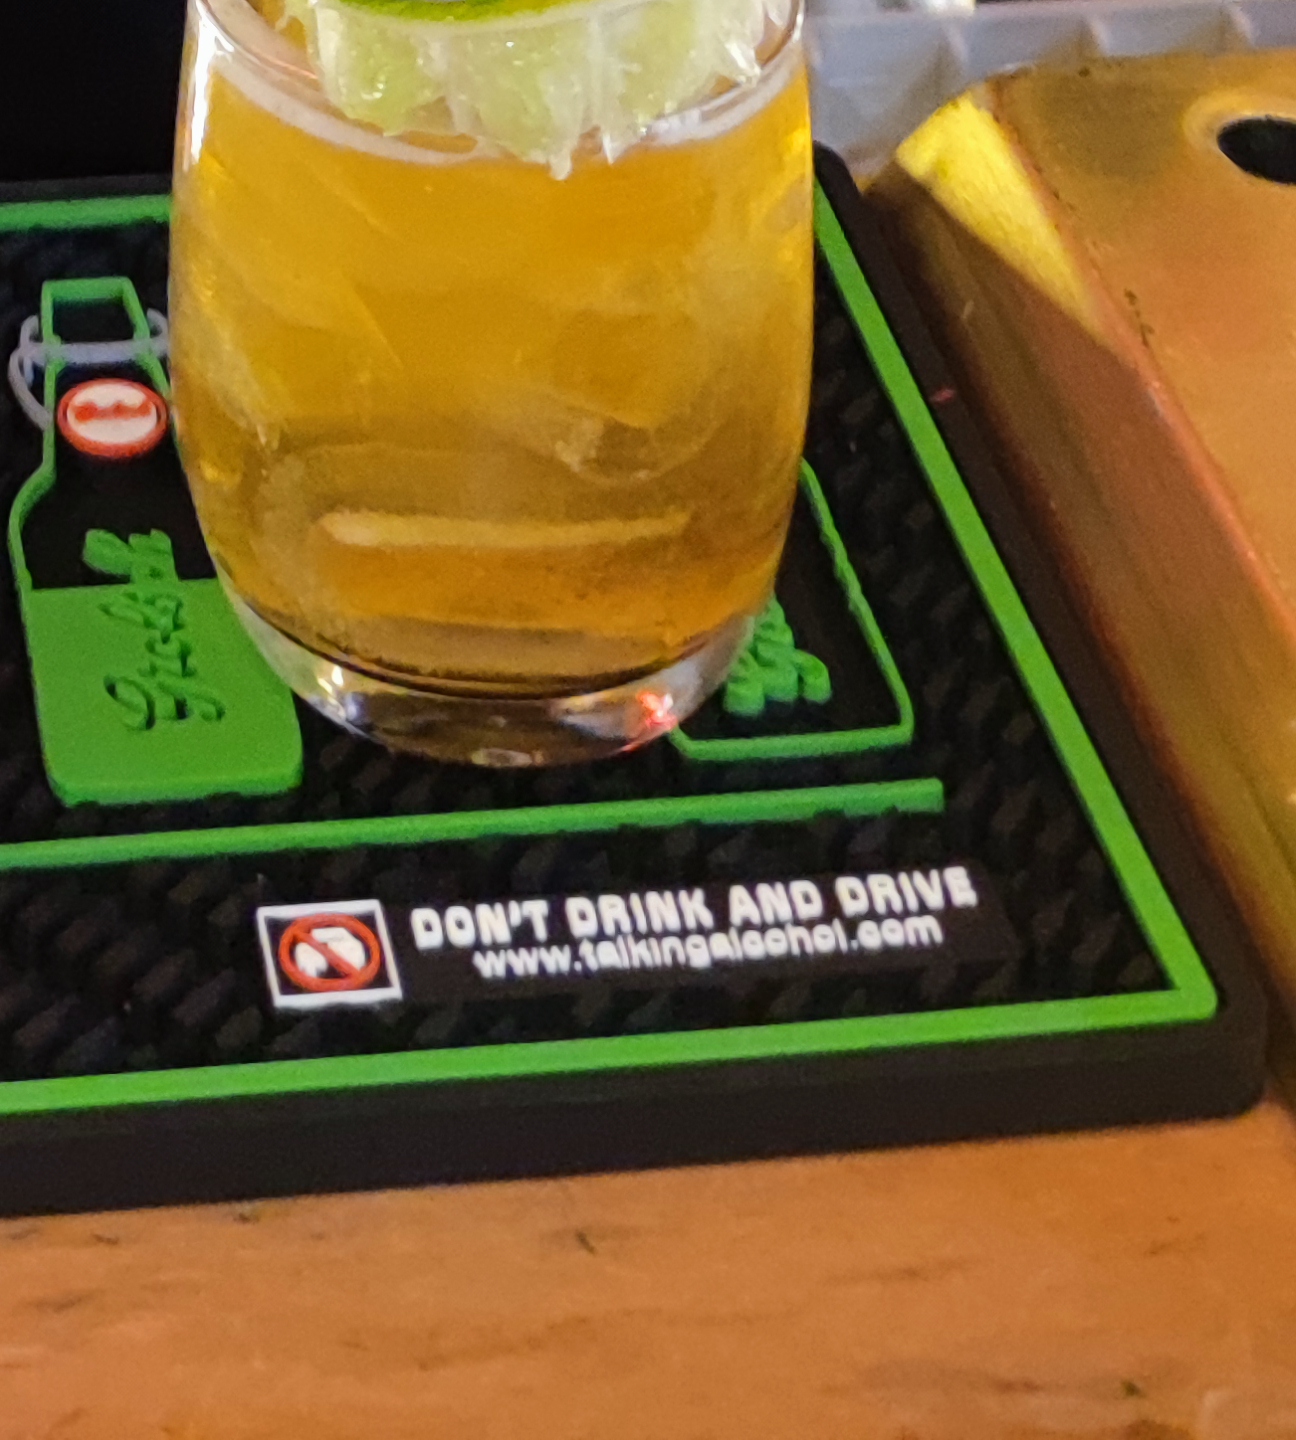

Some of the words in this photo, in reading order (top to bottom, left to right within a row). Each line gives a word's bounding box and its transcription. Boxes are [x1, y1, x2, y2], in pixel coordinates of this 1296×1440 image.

[411, 899, 551, 951] DON'T
[565, 887, 715, 939] DRINK
[728, 880, 824, 925] AND
[834, 866, 978, 918] DRIVE
[473, 914, 944, 979] www.talkingalcohol.com
